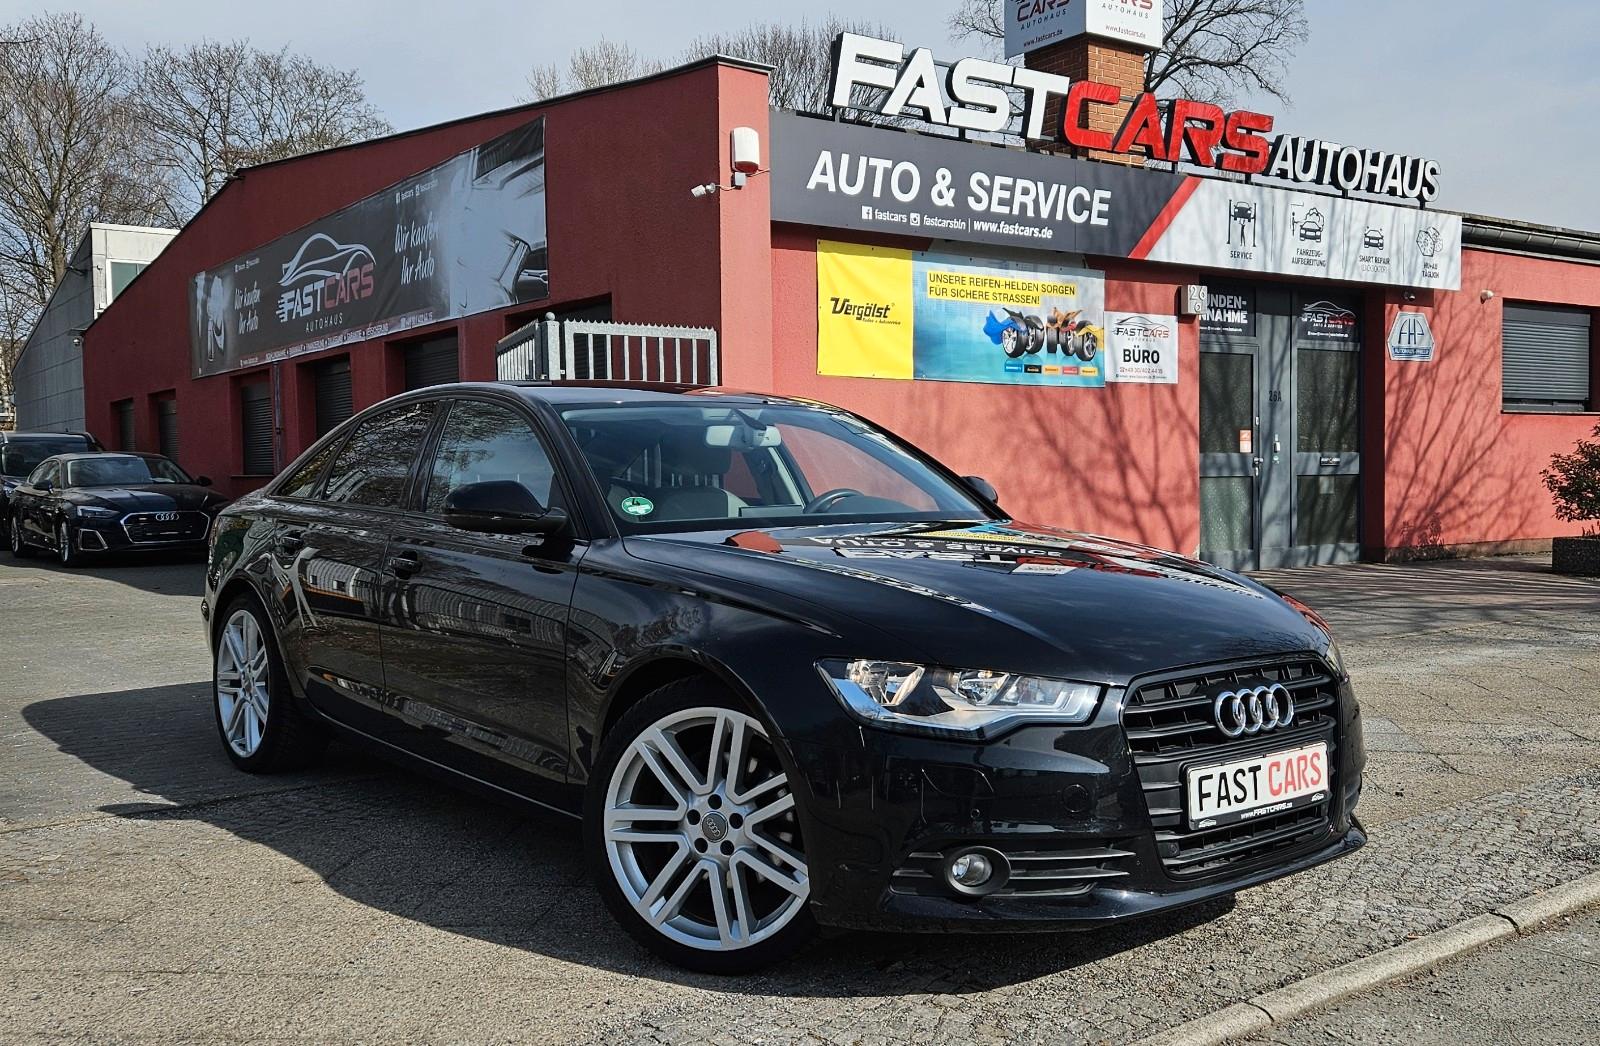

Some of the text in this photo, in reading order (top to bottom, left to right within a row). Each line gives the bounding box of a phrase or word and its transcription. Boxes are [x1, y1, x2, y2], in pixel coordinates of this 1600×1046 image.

[1020, 8, 1067, 30] AUTOHAUS
[1101, 3, 1149, 19] AUTOHAUS
[1269, 134, 1442, 203] AUTOHAUS
[806, 150, 1112, 227] AUTO & SERVICE
[874, 208, 908, 223] fastcars
[973, 219, 1054, 239] www.fastcars.de
[394, 223, 410, 254] Wir
[1229, 250, 1253, 260] SERVICE
[1291, 256, 1327, 268] AUFBEREITUNG
[1359, 255, 1391, 265] SMART REPAIR
[401, 250, 435, 285] Ihr Auto
[929, 273, 1076, 296] UNSERE REIFEN-HELDEN SORGEN
[929, 284, 1041, 305] FÜR SICHERE STRASSEN!
[830, 297, 891, 320] Vergölst
[305, 312, 344, 333] AUTOHAUS
[1123, 344, 1160, 364] BÜRO
[1198, 752, 1322, 812] FAST CARS
